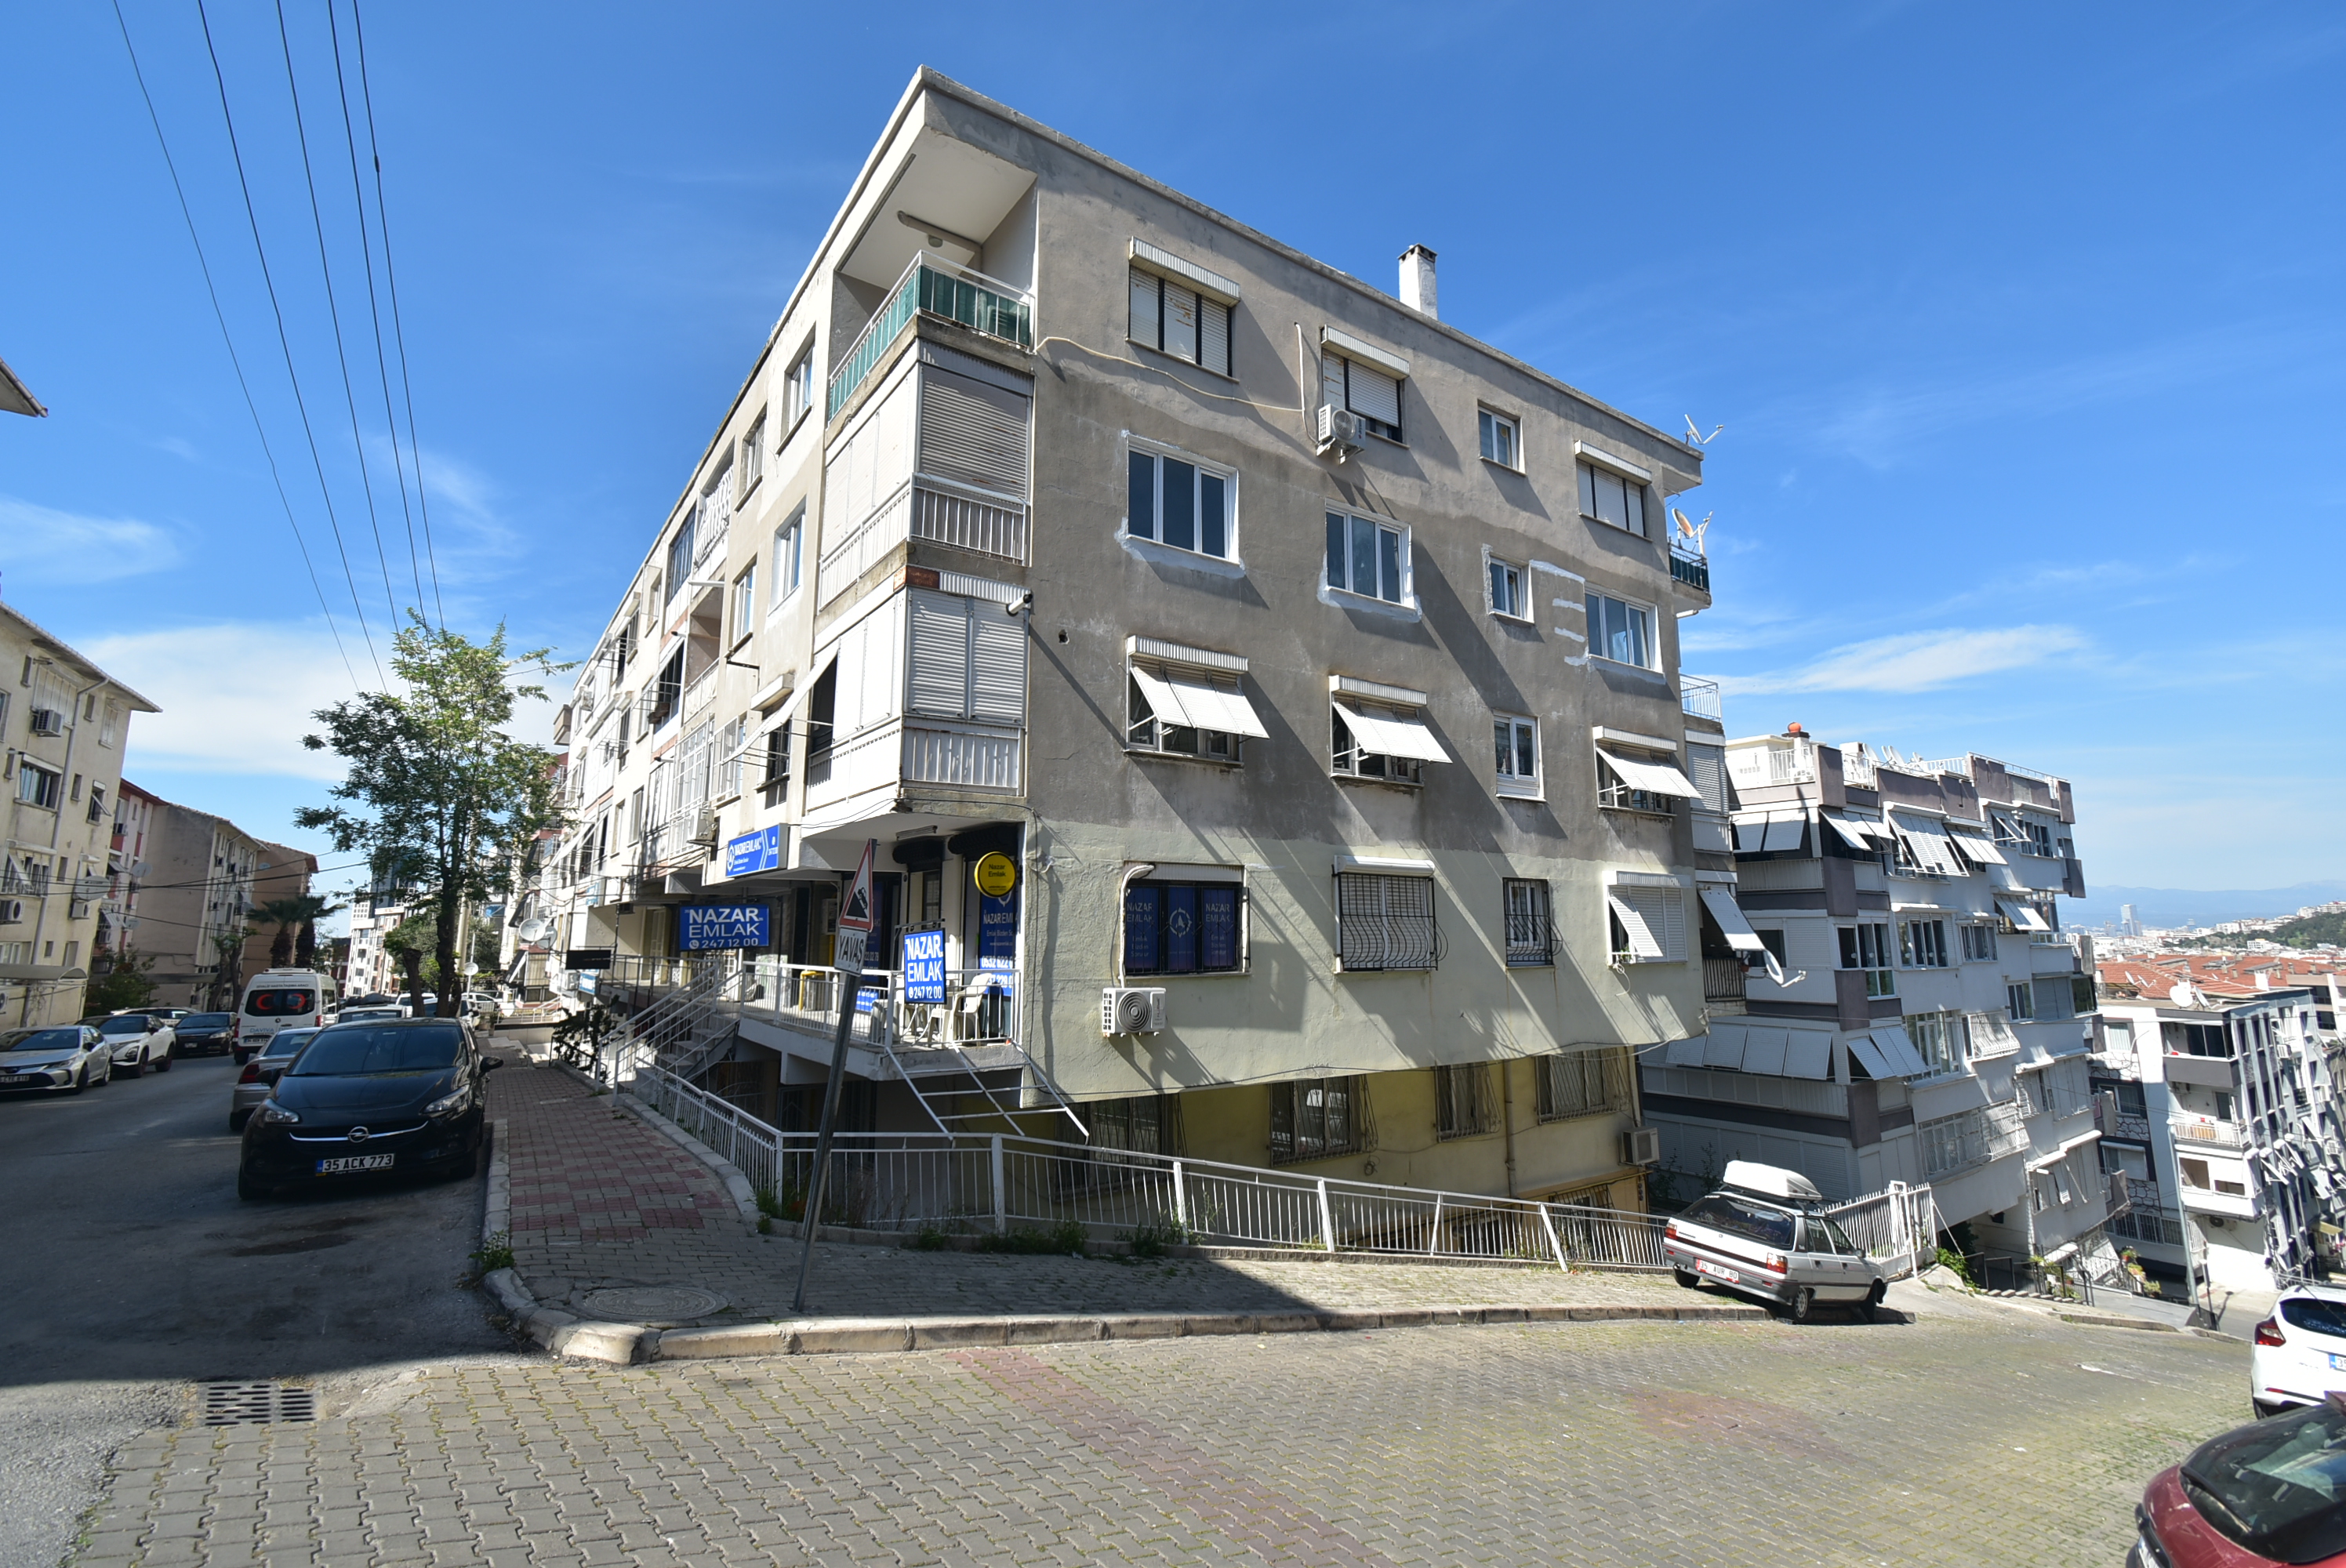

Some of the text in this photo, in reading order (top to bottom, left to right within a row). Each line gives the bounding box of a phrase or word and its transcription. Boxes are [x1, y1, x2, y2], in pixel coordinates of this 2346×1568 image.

[1127, 902, 1153, 912] NAZAR
[1205, 902, 1230, 913] NAZAR
[689, 908, 759, 924] NAZAR
[983, 913, 1001, 924] NAZAR
[689, 923, 760, 938] EMLAK
[702, 939, 724, 949] 247
[743, 938, 758, 946] 00
[907, 935, 942, 960] NAZAR
[838, 935, 864, 971] YAVAŞ
[908, 960, 942, 982] EMLAK
[914, 985, 942, 999] 247 12 00
[324, 1155, 393, 1171] 35 ACK 773
[1700, 1261, 1708, 1270] 35
[1713, 1265, 1726, 1276] AUR
